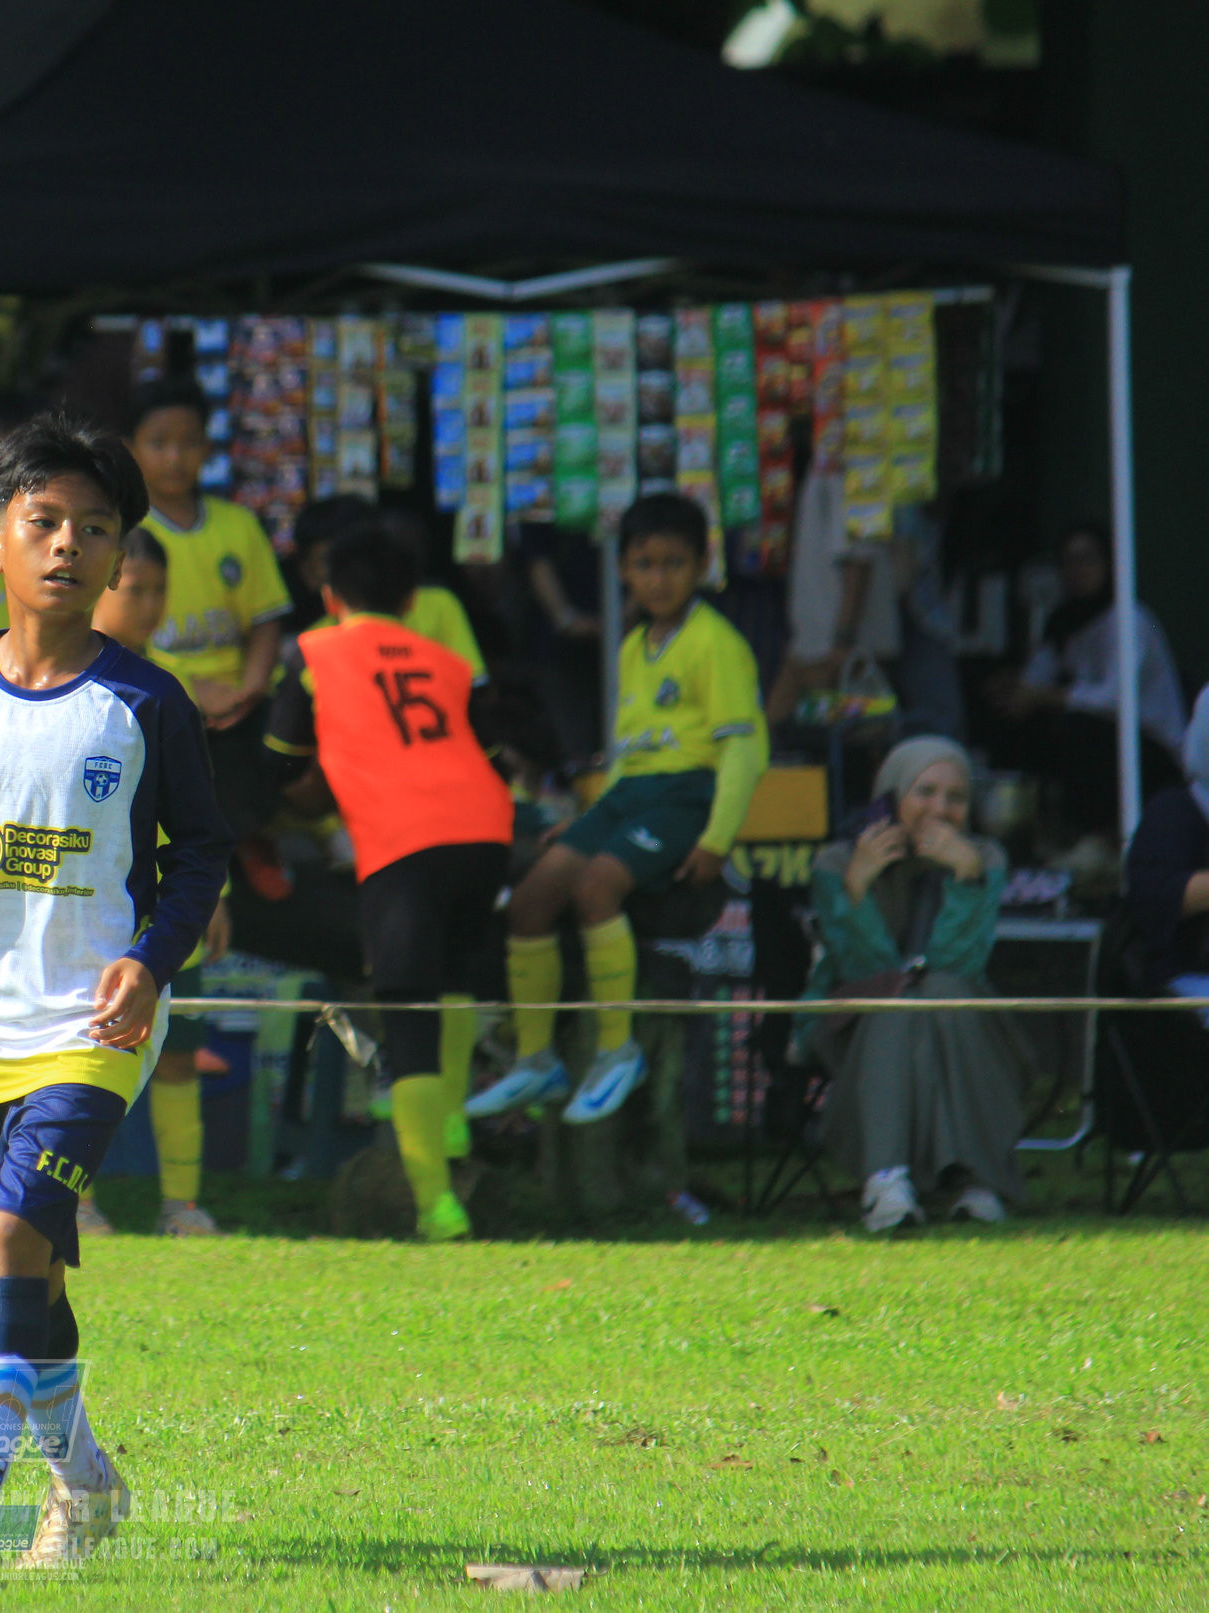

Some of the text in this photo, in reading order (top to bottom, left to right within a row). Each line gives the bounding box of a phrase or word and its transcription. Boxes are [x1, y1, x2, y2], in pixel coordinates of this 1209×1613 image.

[373, 670, 448, 747] 15
[4, 827, 89, 849] Decorasiku
[4, 843, 57, 862] Inovasi
[4, 858, 52, 880] Group
